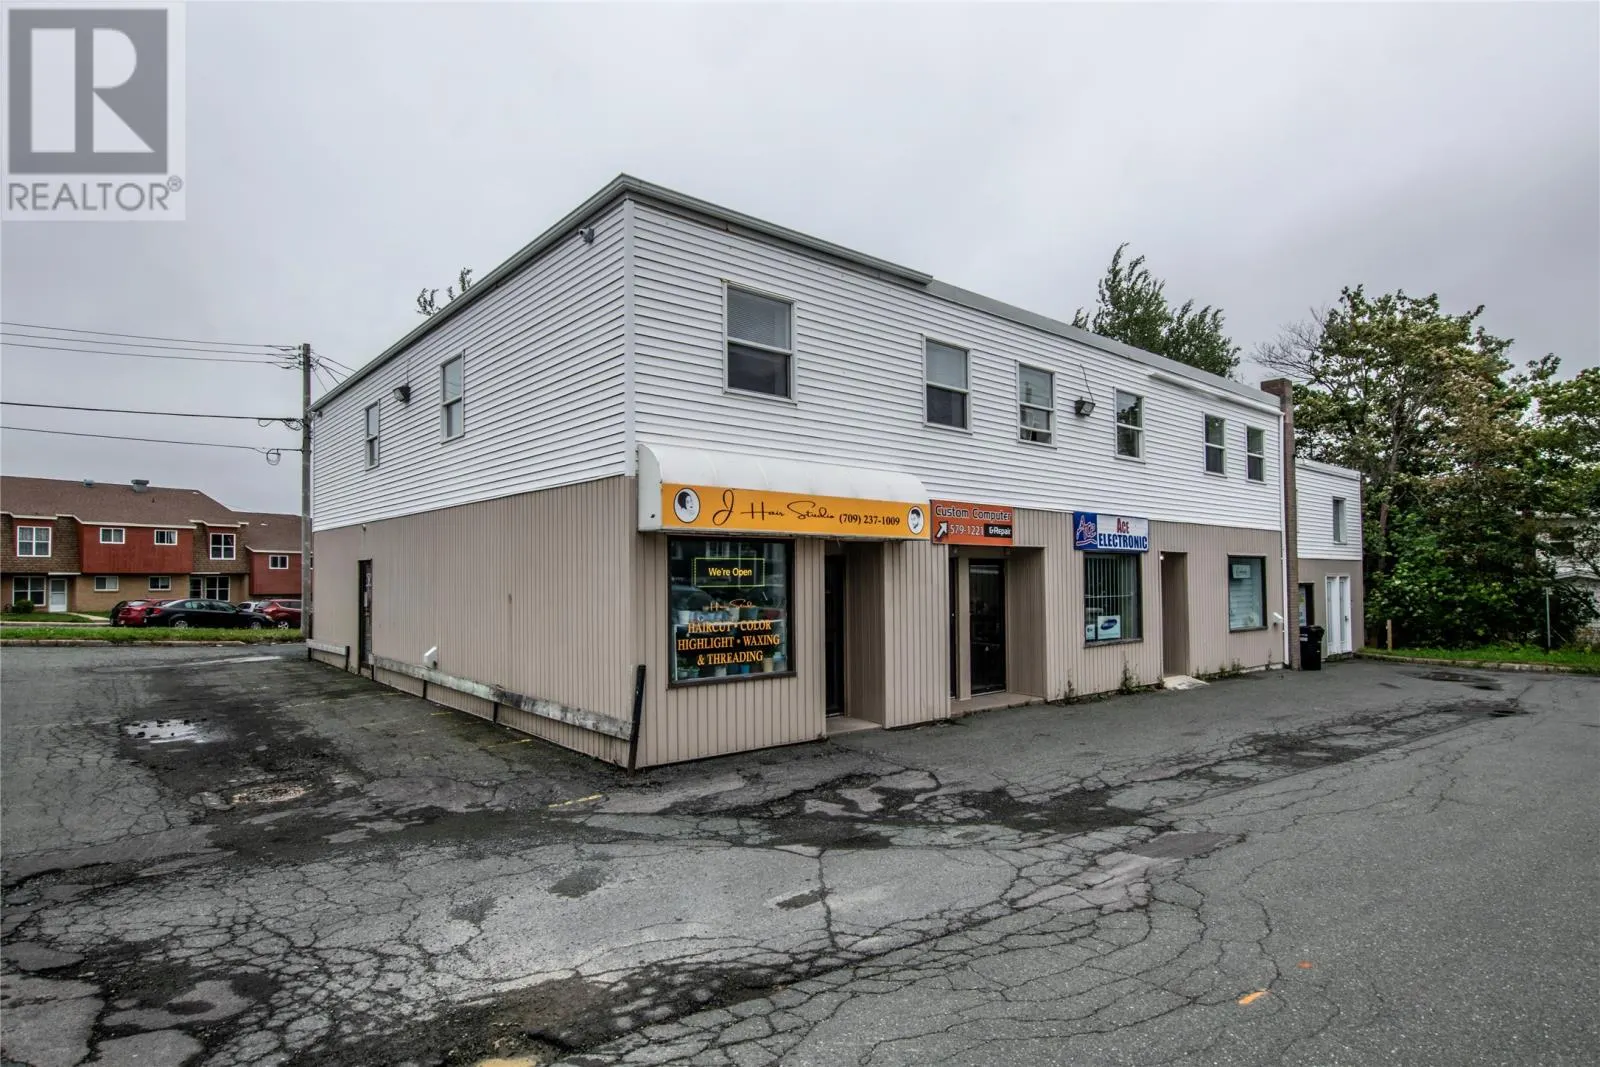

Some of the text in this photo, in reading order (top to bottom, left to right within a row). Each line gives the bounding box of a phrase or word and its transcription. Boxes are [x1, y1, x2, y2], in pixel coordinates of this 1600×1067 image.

[838, 513, 862, 525] (709)
[863, 514, 900, 526] 237-1009
[935, 504, 1012, 522] Custom Computer
[950, 524, 984, 536] 579-1221
[1098, 533, 1148, 549] ELECTRONIC
[708, 567, 752, 577] We're Open
[687, 620, 772, 634] HAIRCUT COLOR
[678, 634, 780, 651] HIGHLIGHT WAXING
[697, 650, 764, 666] & THREADING
